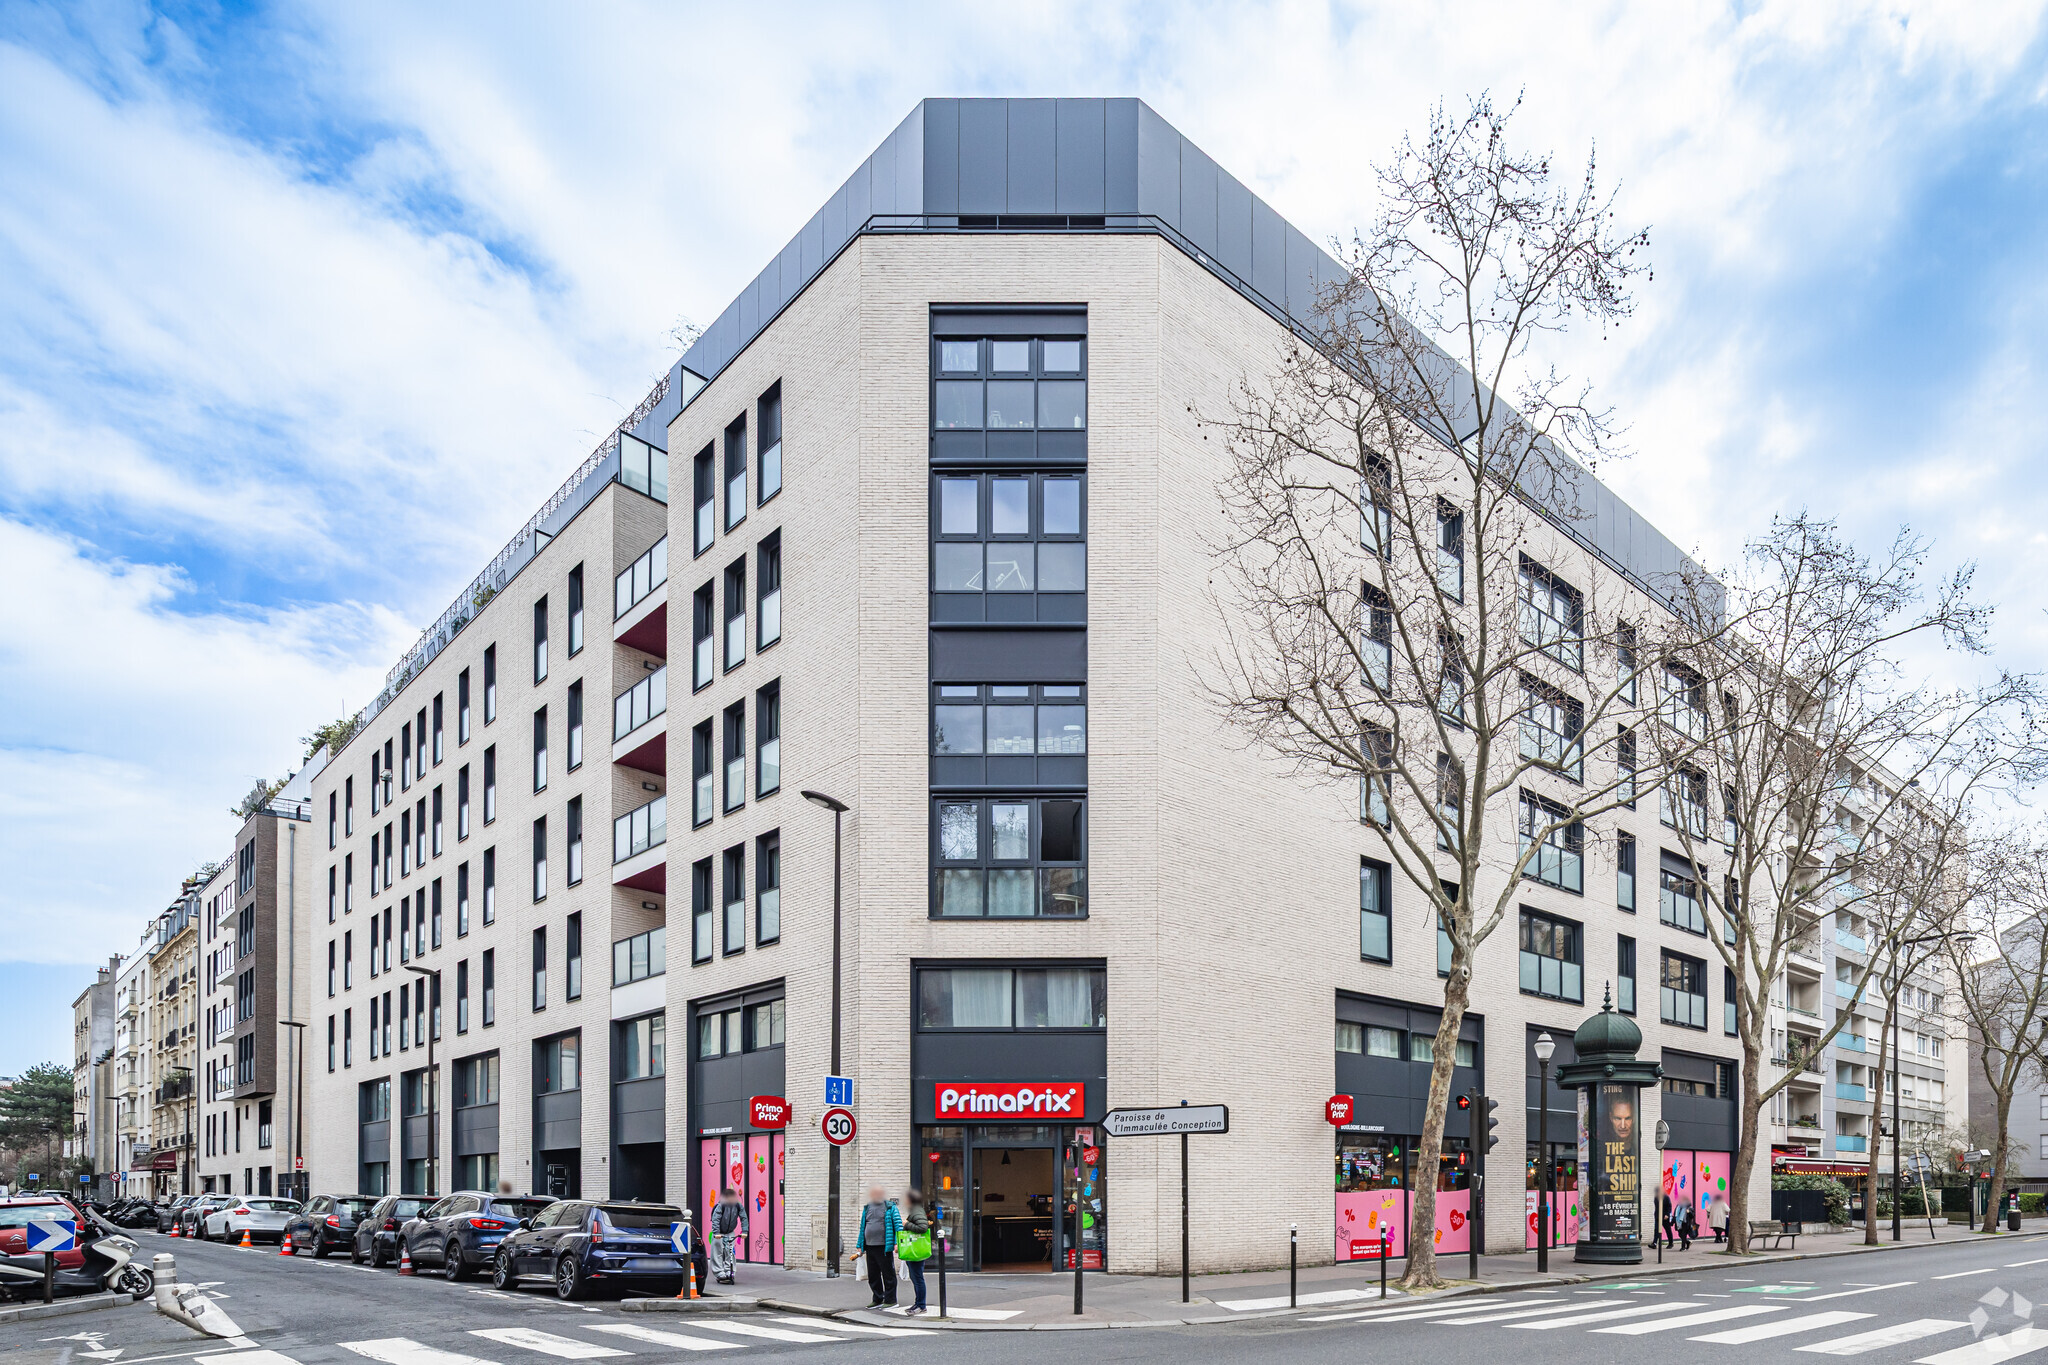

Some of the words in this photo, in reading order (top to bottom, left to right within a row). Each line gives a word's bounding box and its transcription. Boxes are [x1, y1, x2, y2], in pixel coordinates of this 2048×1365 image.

[1603, 1085, 1623, 1093] STING
[941, 1088, 1073, 1112] PrimaPrix
[755, 1103, 783, 1112] Prima
[1330, 1102, 1348, 1110] Prima
[758, 1112, 779, 1121] Prix
[1114, 1113, 1151, 1122] Paroisse
[1154, 1112, 1165, 1120] de
[1332, 1110, 1345, 1118] Prix
[829, 1118, 851, 1135] 30
[1114, 1122, 1168, 1132] l'Immaculée
[1171, 1119, 1222, 1130] Conception
[1605, 1142, 1625, 1155] THE
[1605, 1156, 1635, 1173] LAST
[1610, 1174, 1637, 1191] SHIP
